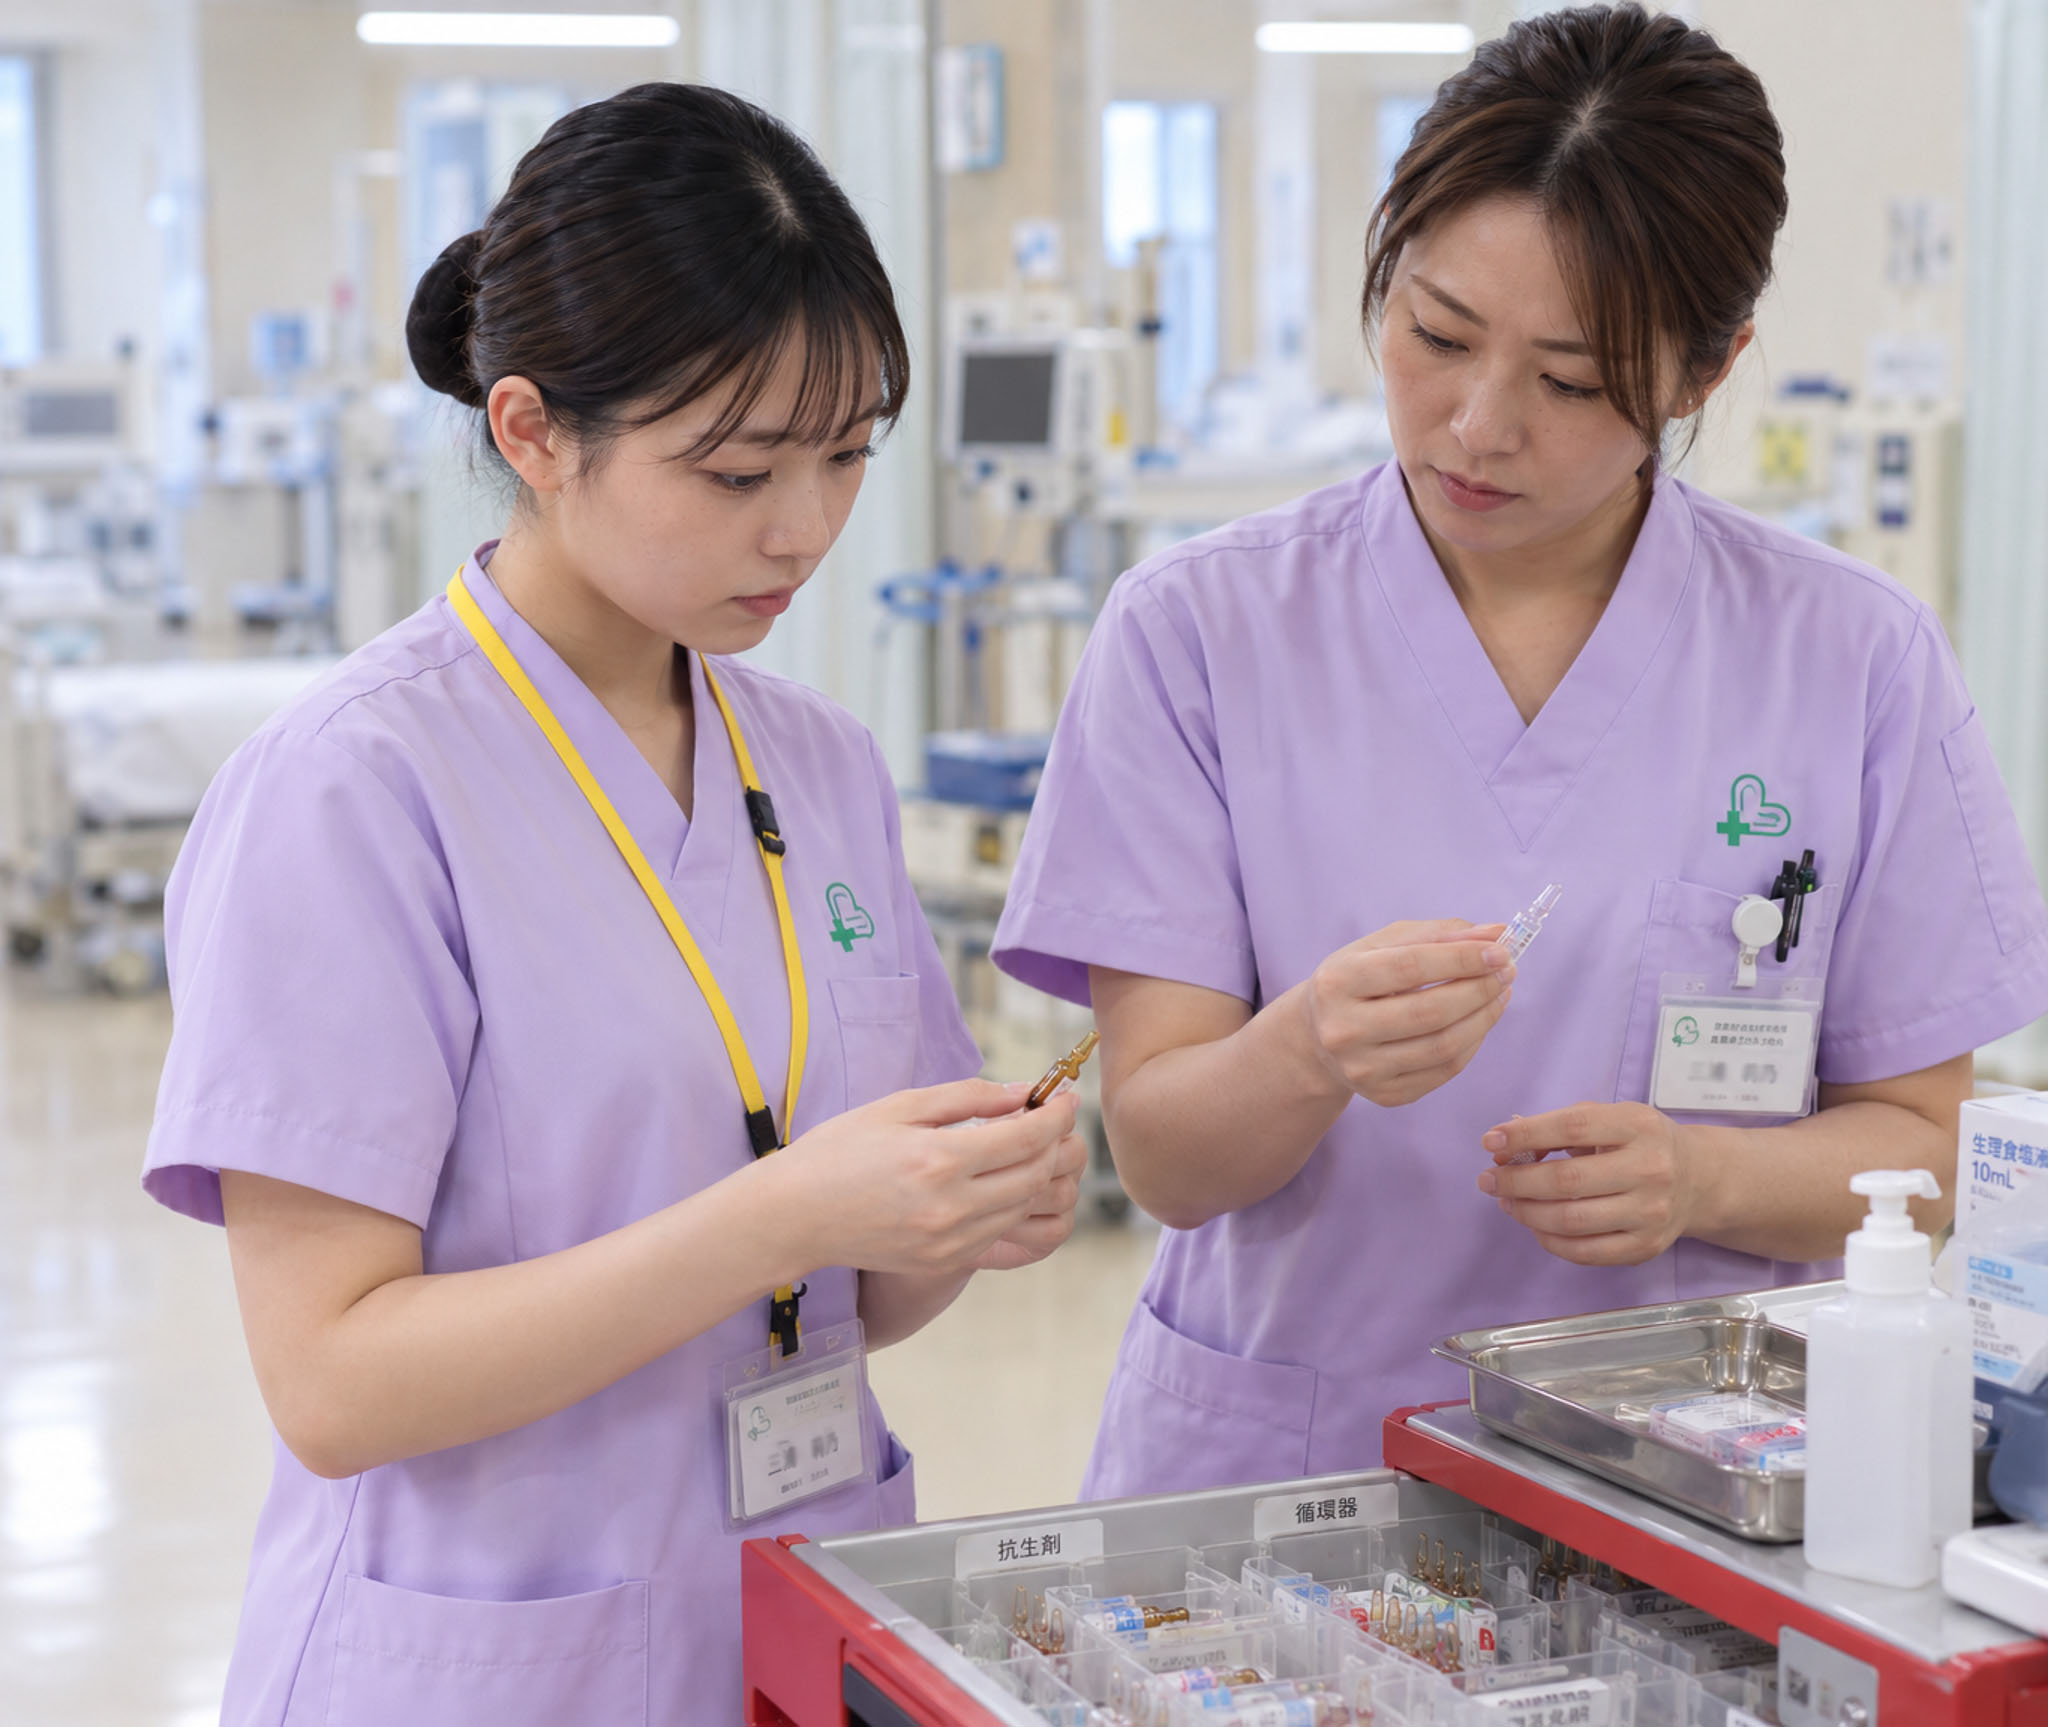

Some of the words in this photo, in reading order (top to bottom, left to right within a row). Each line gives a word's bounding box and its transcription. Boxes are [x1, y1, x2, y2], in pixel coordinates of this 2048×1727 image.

[1972, 1160, 2015, 1190] 10mL
[1296, 1497, 1357, 1524] 循環器
[998, 1533, 1061, 1561] 抗生剤
